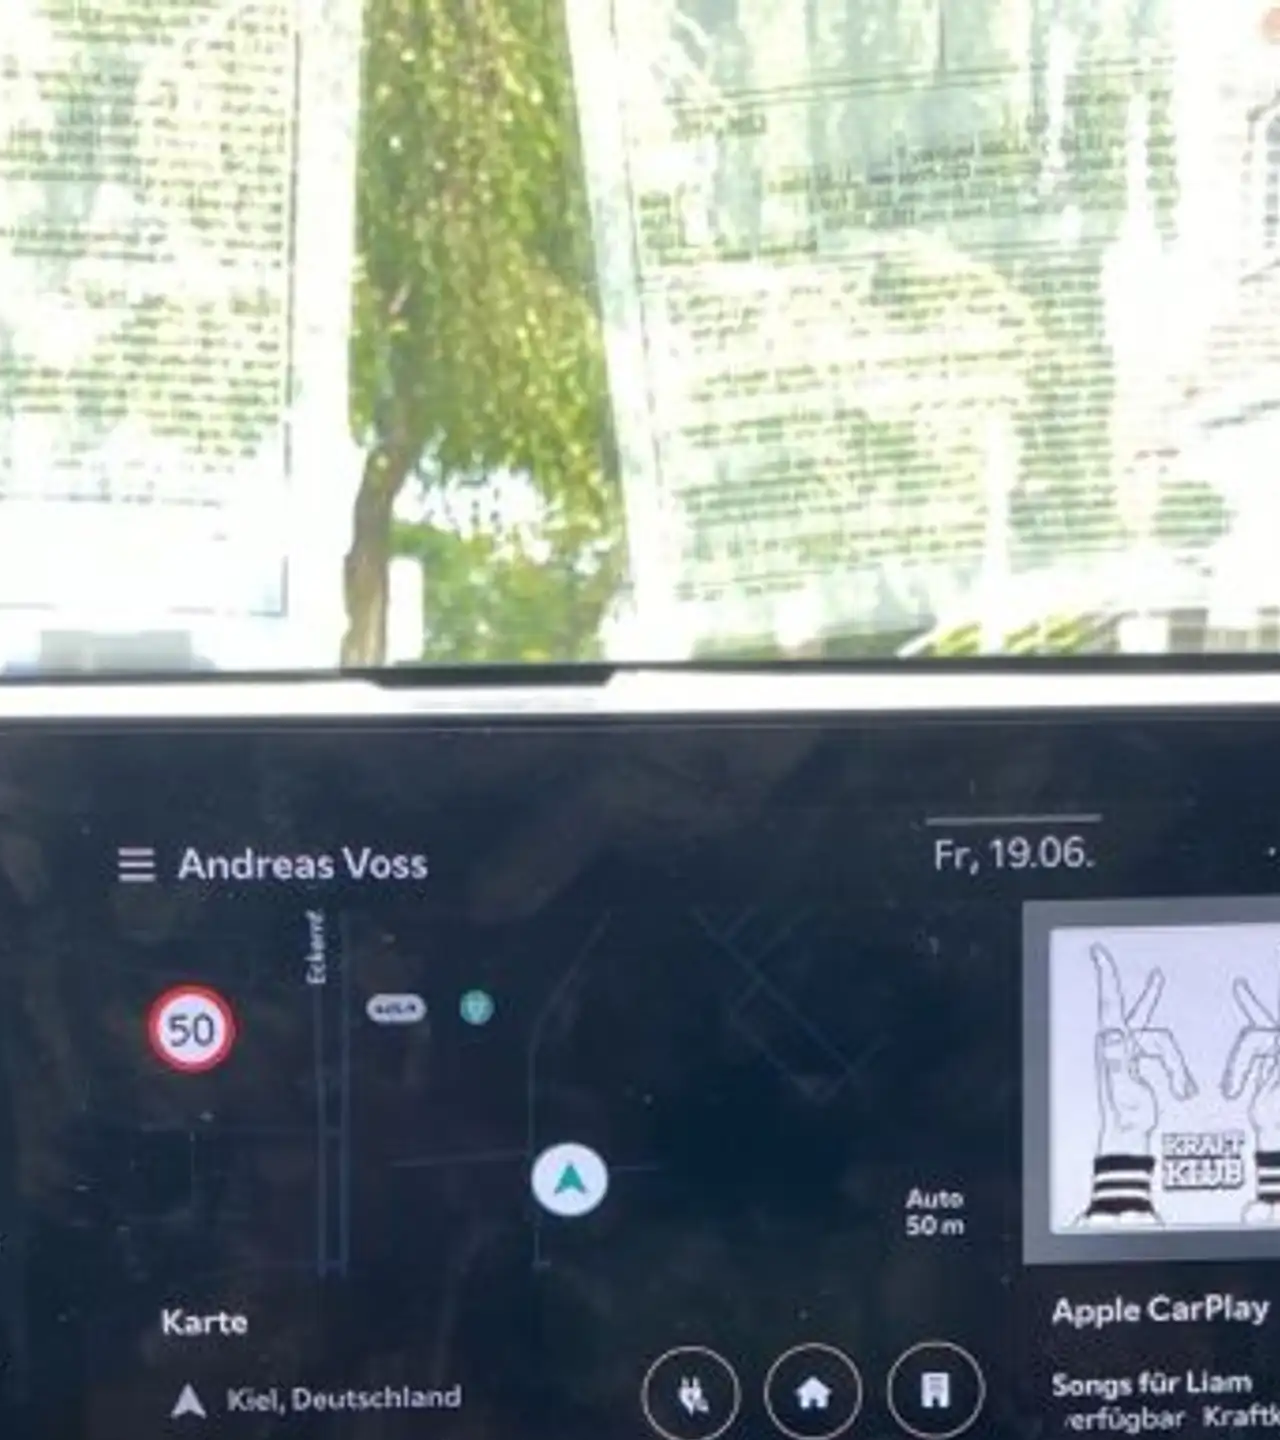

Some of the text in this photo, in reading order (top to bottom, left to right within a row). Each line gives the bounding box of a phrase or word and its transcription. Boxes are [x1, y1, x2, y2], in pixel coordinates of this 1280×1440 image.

[177, 846, 428, 881] Andreas Voss
[934, 836, 1095, 875] Fr, 19.06.
[168, 1012, 216, 1048] 50
[1162, 1159, 1246, 1190] KLUB
[905, 1186, 965, 1210] Auto
[905, 1215, 966, 1237] 50 m
[161, 1308, 249, 1337] Karte
[1052, 1294, 1271, 1329] Apple CarPlay
[227, 1383, 461, 1415] Kiel, Deutschland
[1052, 1369, 1253, 1401] Songs für Liam
